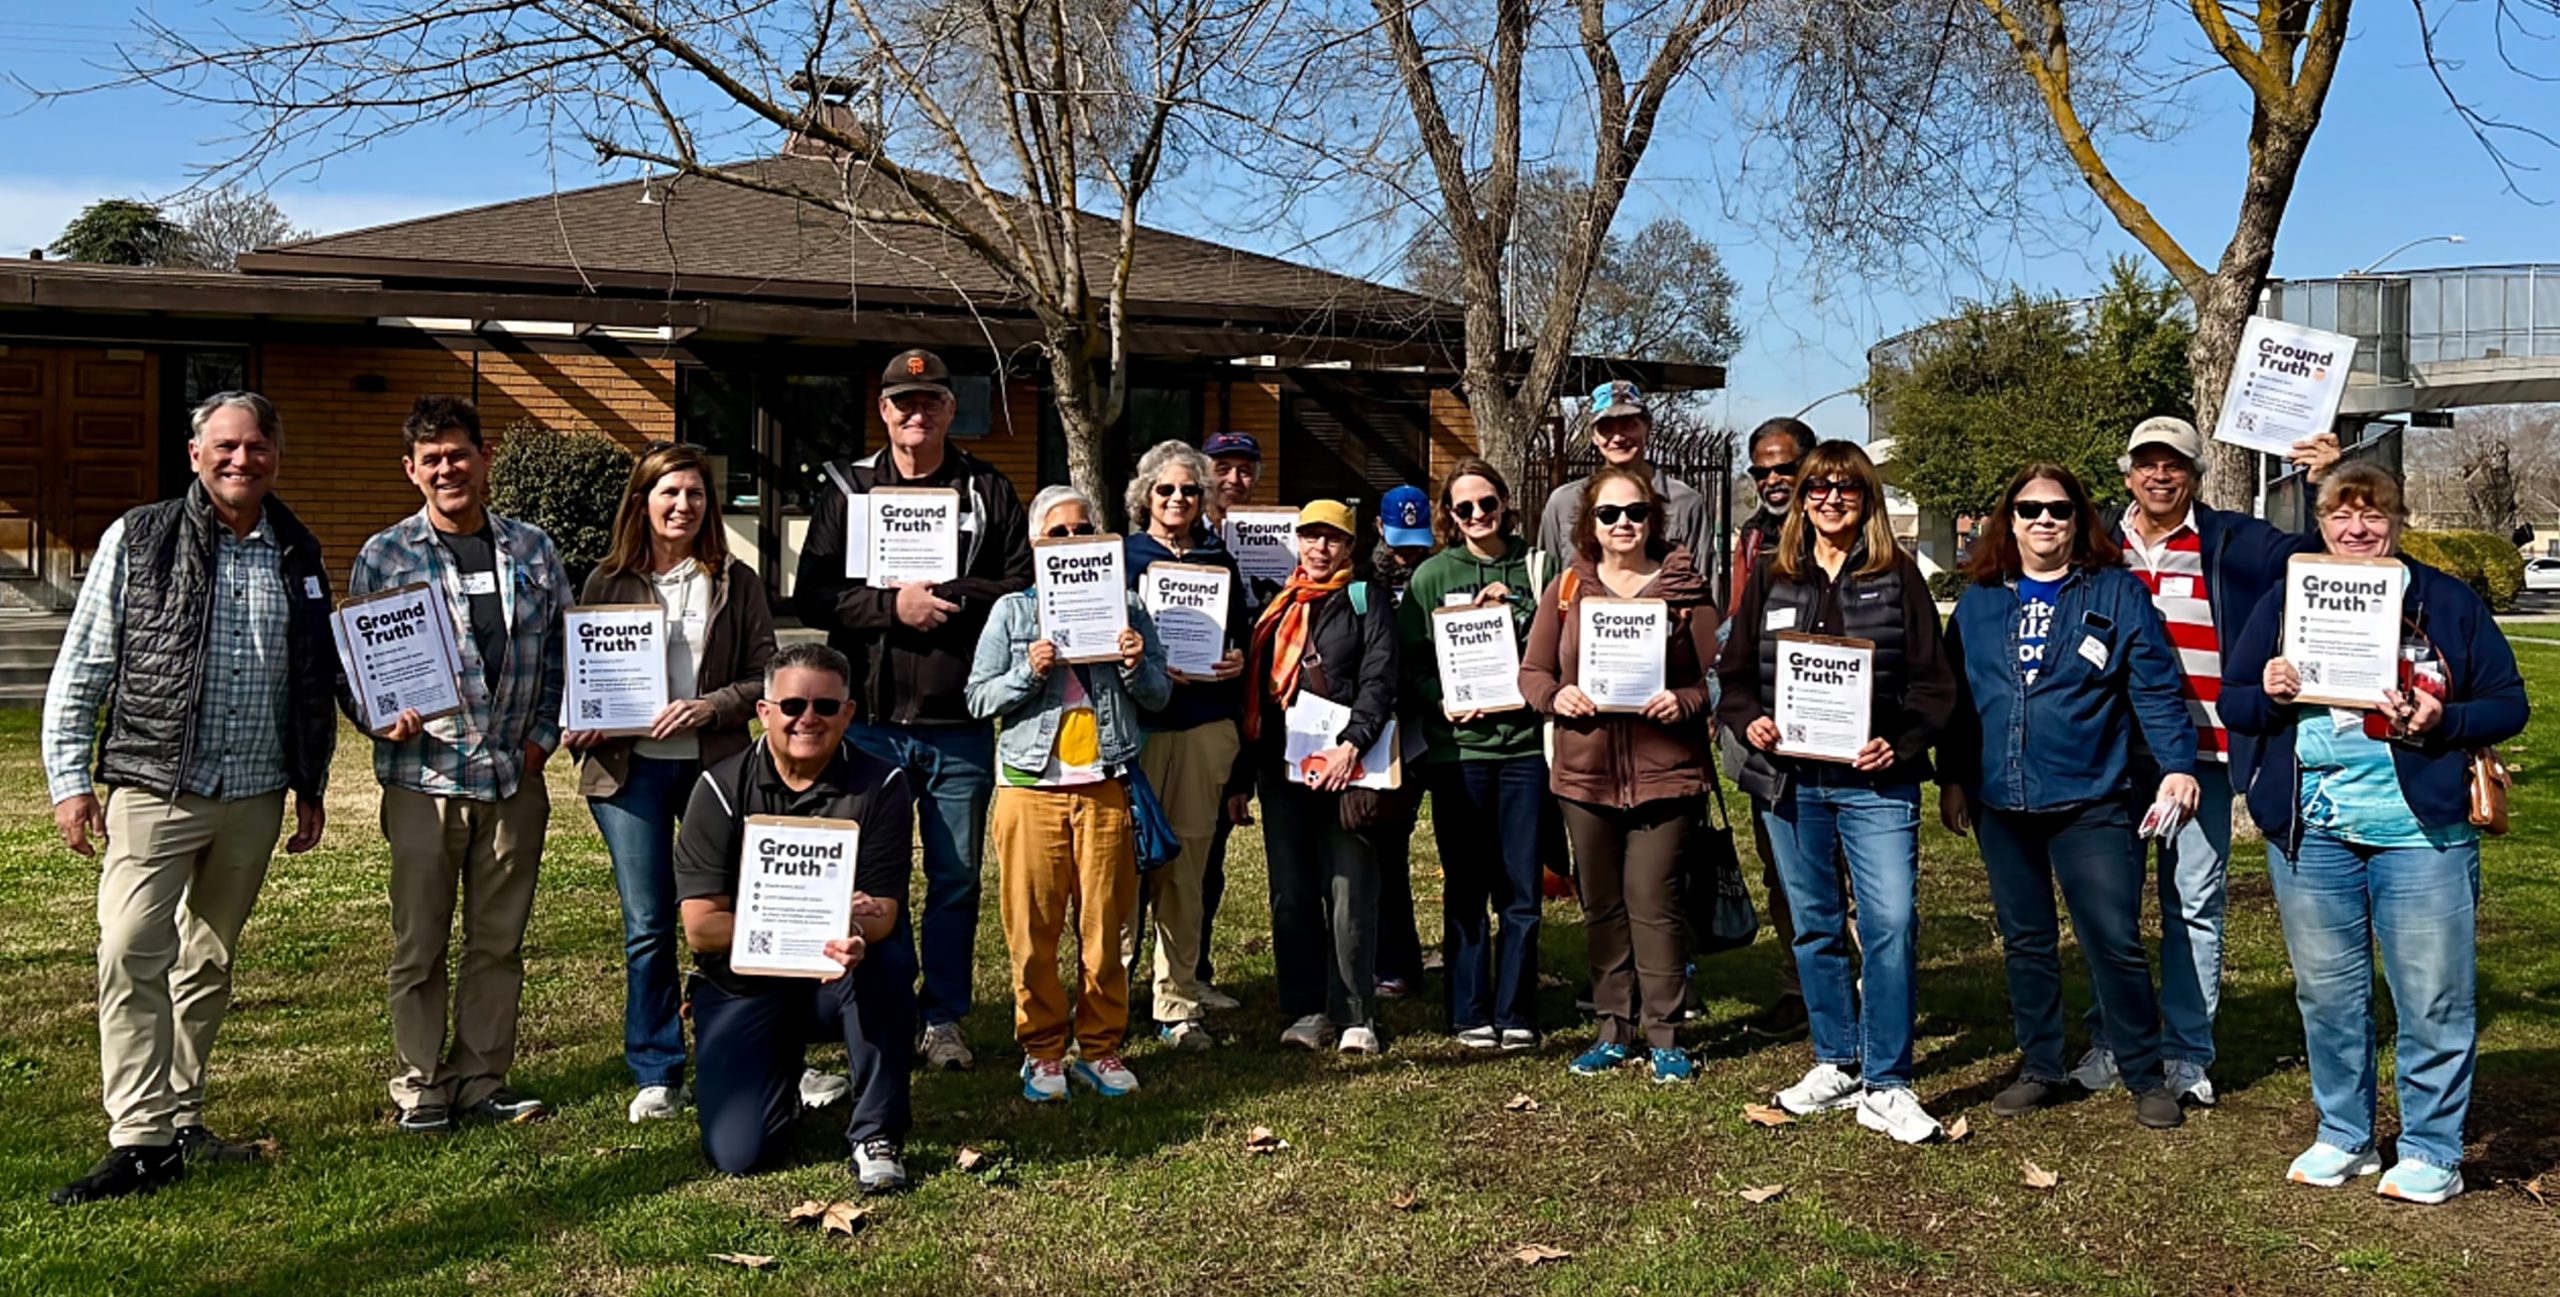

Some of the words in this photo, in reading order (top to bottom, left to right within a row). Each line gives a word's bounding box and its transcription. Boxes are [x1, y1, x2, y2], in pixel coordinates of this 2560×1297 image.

[2258, 337, 2334, 367] Ground
[2257, 353, 2311, 378] Truth
[880, 504, 946, 519] Ground
[883, 518, 931, 532] Truth
[1235, 521, 1291, 534] Ground
[1237, 533, 1278, 546] Truth
[1047, 552, 1113, 570] Ground
[1049, 569, 1099, 585] Truth
[1158, 577, 1219, 594] Ground
[2302, 575, 2387, 596] Ground
[1159, 591, 1203, 607] Truth
[2304, 593, 2366, 612] Truth
[356, 602, 426, 631] Ground
[1445, 616, 1504, 634] Ground
[1592, 612, 1656, 626] Ground
[362, 622, 415, 647] Truth
[578, 622, 653, 638] Ground
[1448, 630, 1492, 647] Truth
[1594, 625, 1640, 639] Truth
[581, 637, 637, 653] Truth
[1789, 652, 1861, 672] Ground
[1791, 667, 1843, 685] Truth
[759, 838, 843, 860] Ground
[760, 857, 822, 877] Truth
